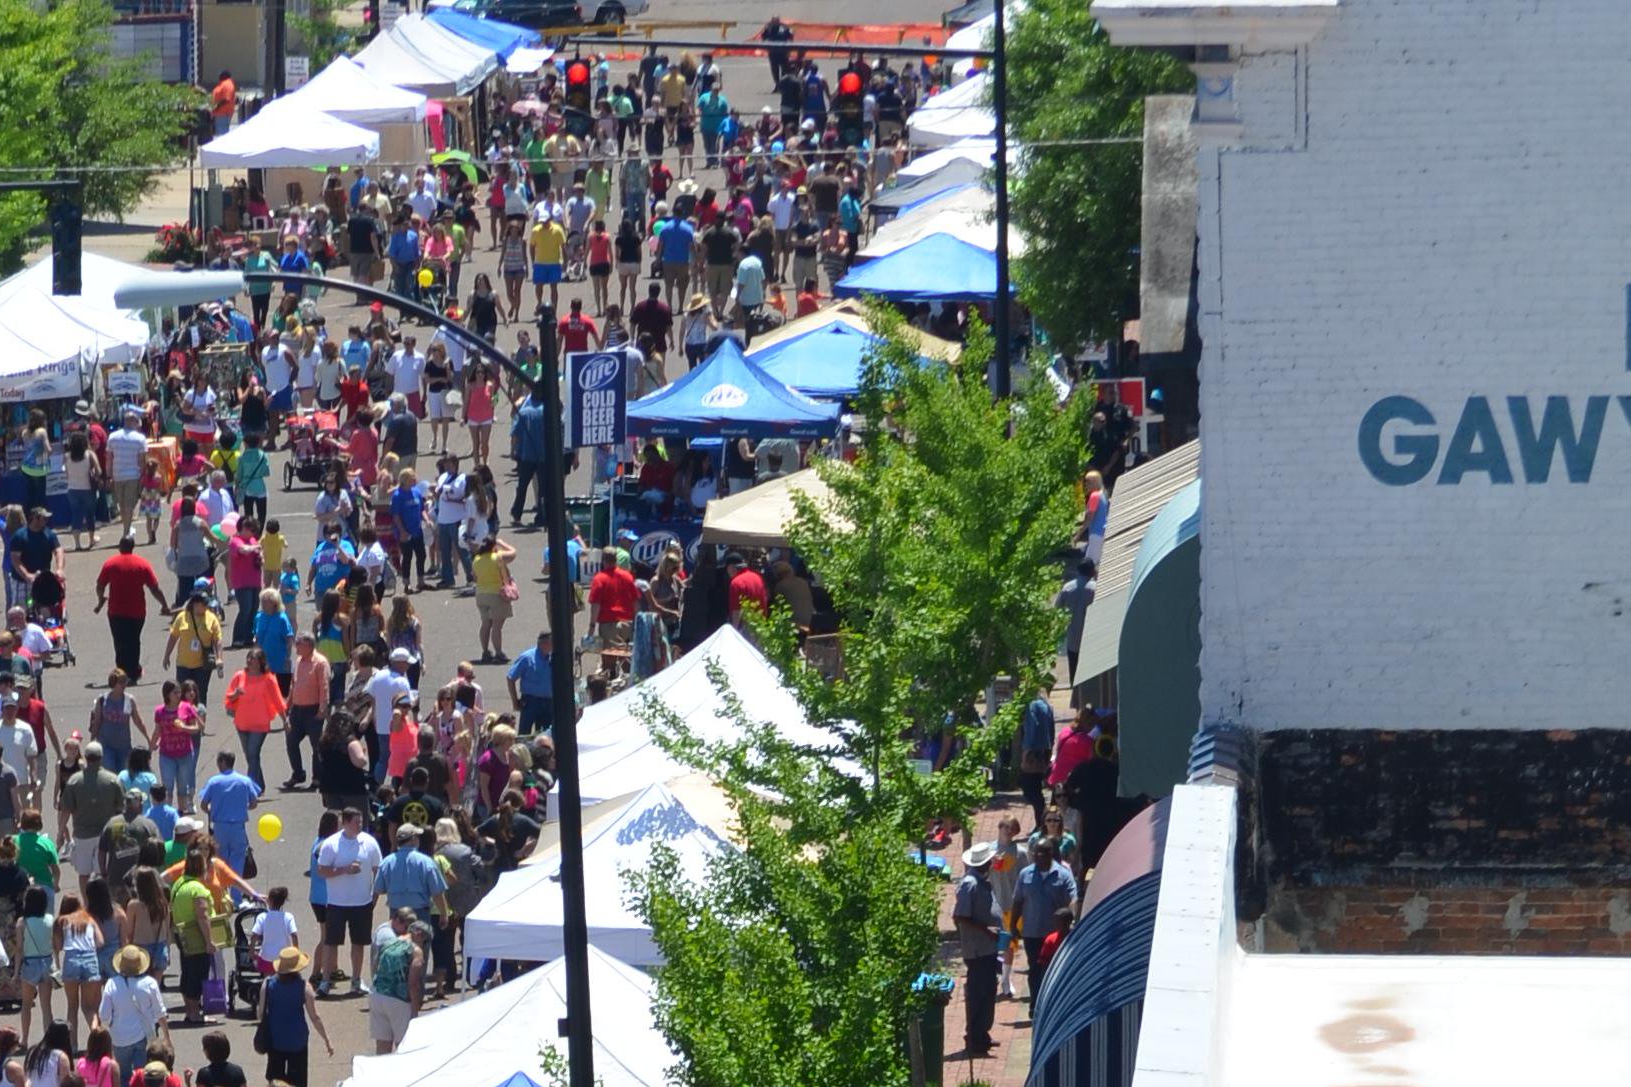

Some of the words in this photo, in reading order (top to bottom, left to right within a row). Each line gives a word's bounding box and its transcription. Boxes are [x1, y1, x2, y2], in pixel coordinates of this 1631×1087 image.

[0, 387, 25, 400] Today
[582, 390, 616, 408] COLD
[582, 407, 615, 427] BEER
[582, 425, 615, 445] HERE
